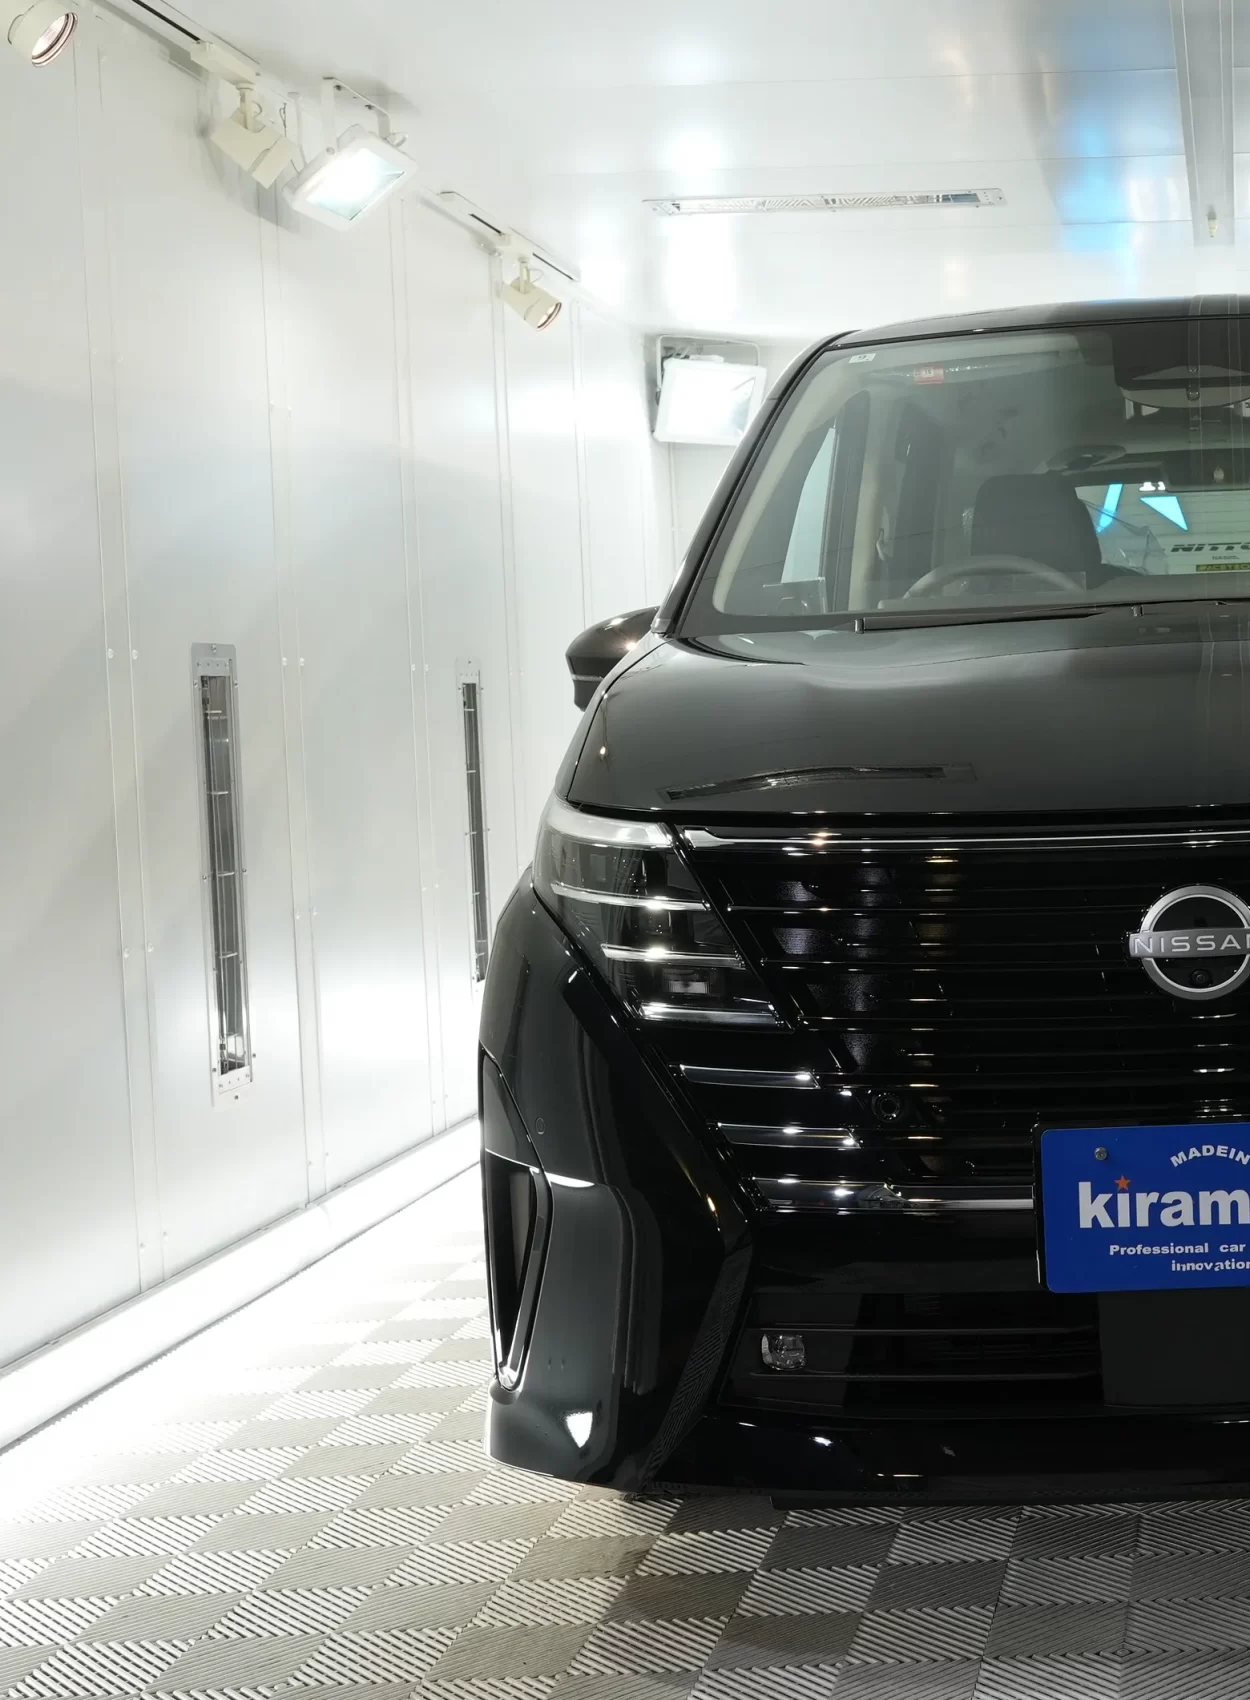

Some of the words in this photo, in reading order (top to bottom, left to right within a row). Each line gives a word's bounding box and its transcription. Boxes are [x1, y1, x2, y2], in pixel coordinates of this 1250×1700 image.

[1170, 1144, 1250, 1167] MADEIN
[1109, 1242, 1209, 1255] Professional
[1219, 1243, 1246, 1253] car
